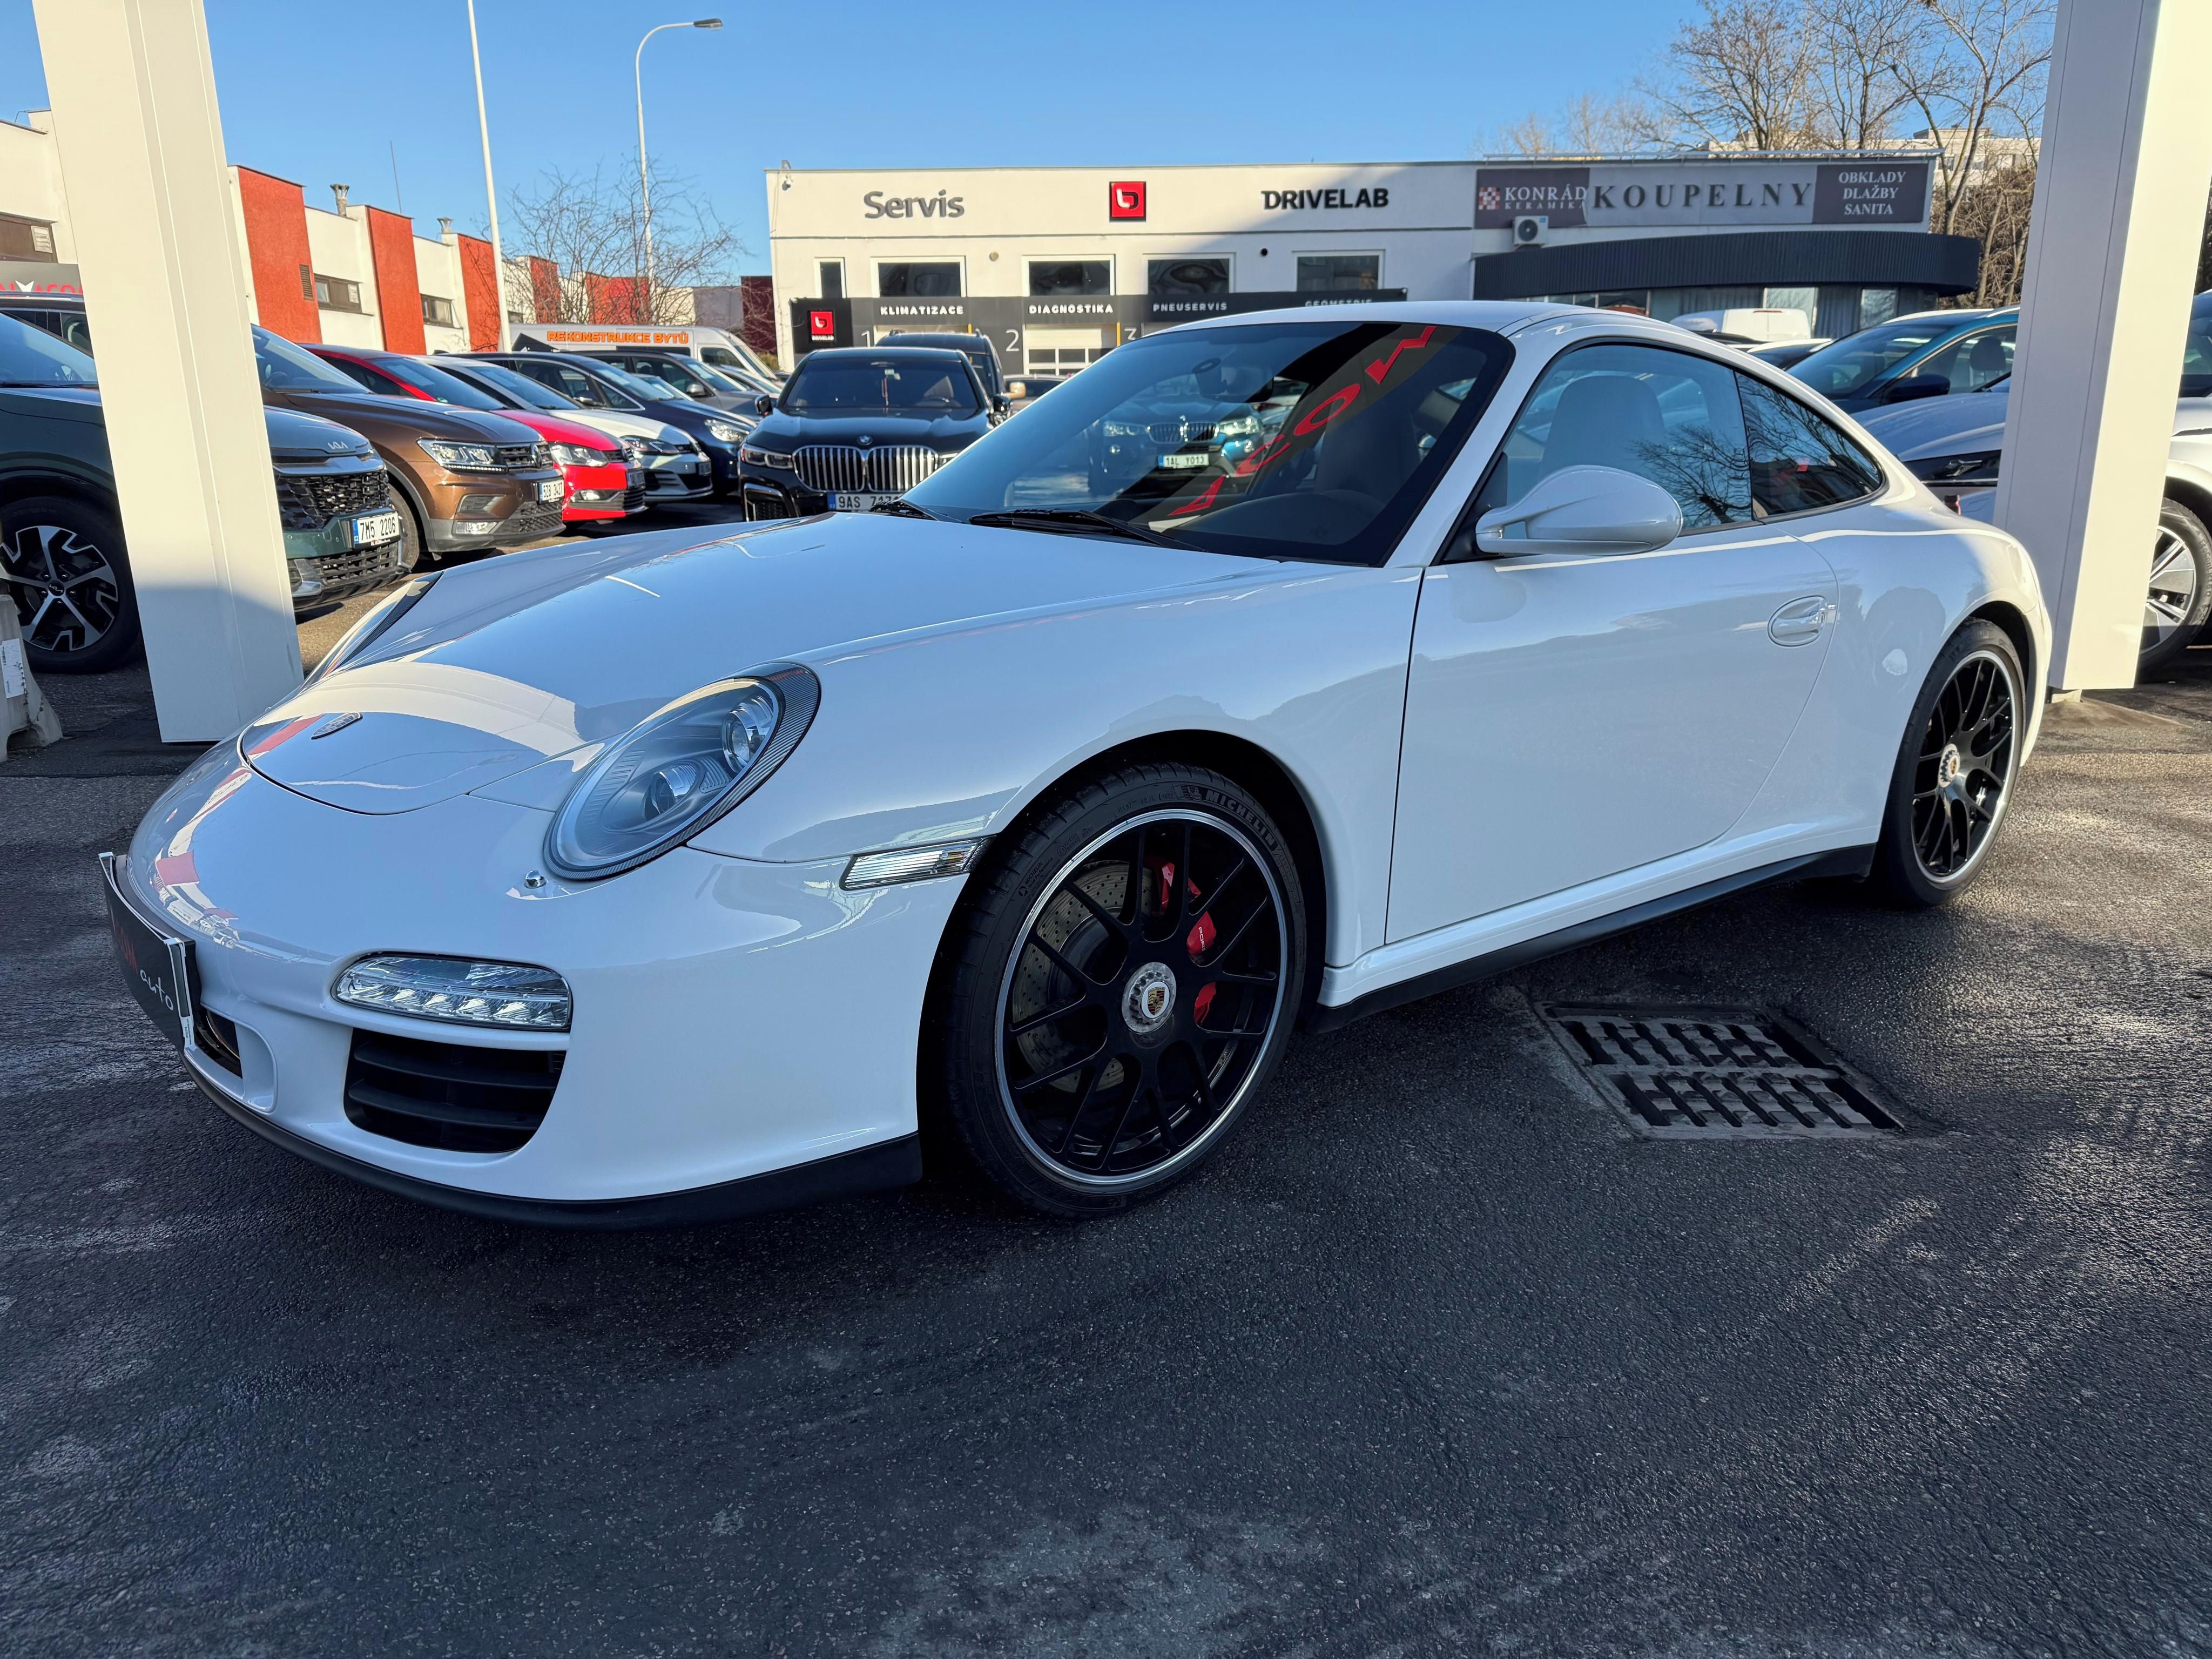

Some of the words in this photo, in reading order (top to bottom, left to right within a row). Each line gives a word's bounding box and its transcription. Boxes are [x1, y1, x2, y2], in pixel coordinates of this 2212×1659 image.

[1838, 171, 1906, 183] OBKLADY
[1260, 188, 1388, 210] DRIVELAB
[1505, 184, 1587, 200] KONRÁD
[1593, 183, 1811, 208] KOUPELNY
[1843, 184, 1898, 199] DLAŽBY
[864, 189, 965, 219] Servis
[1844, 203, 1893, 215] SANITA
[880, 305, 963, 315] KLIMATIZACE
[1029, 304, 1114, 314] DIAGNOSTIKA
[1153, 302, 1228, 312] PNEUSERVIS
[547, 331, 651, 343] REKONSTRUKCE
[654, 332, 689, 344] BYTŮ
[861, 330, 871, 348] 1
[1006, 329, 1020, 352] 2
[839, 496, 860, 508] 9AS
[360, 521, 375, 541] 7M5
[380, 516, 396, 536] 2206
[1205, 790, 1276, 846] MICHELIN
[1026, 861, 1043, 885] MICHELIN
